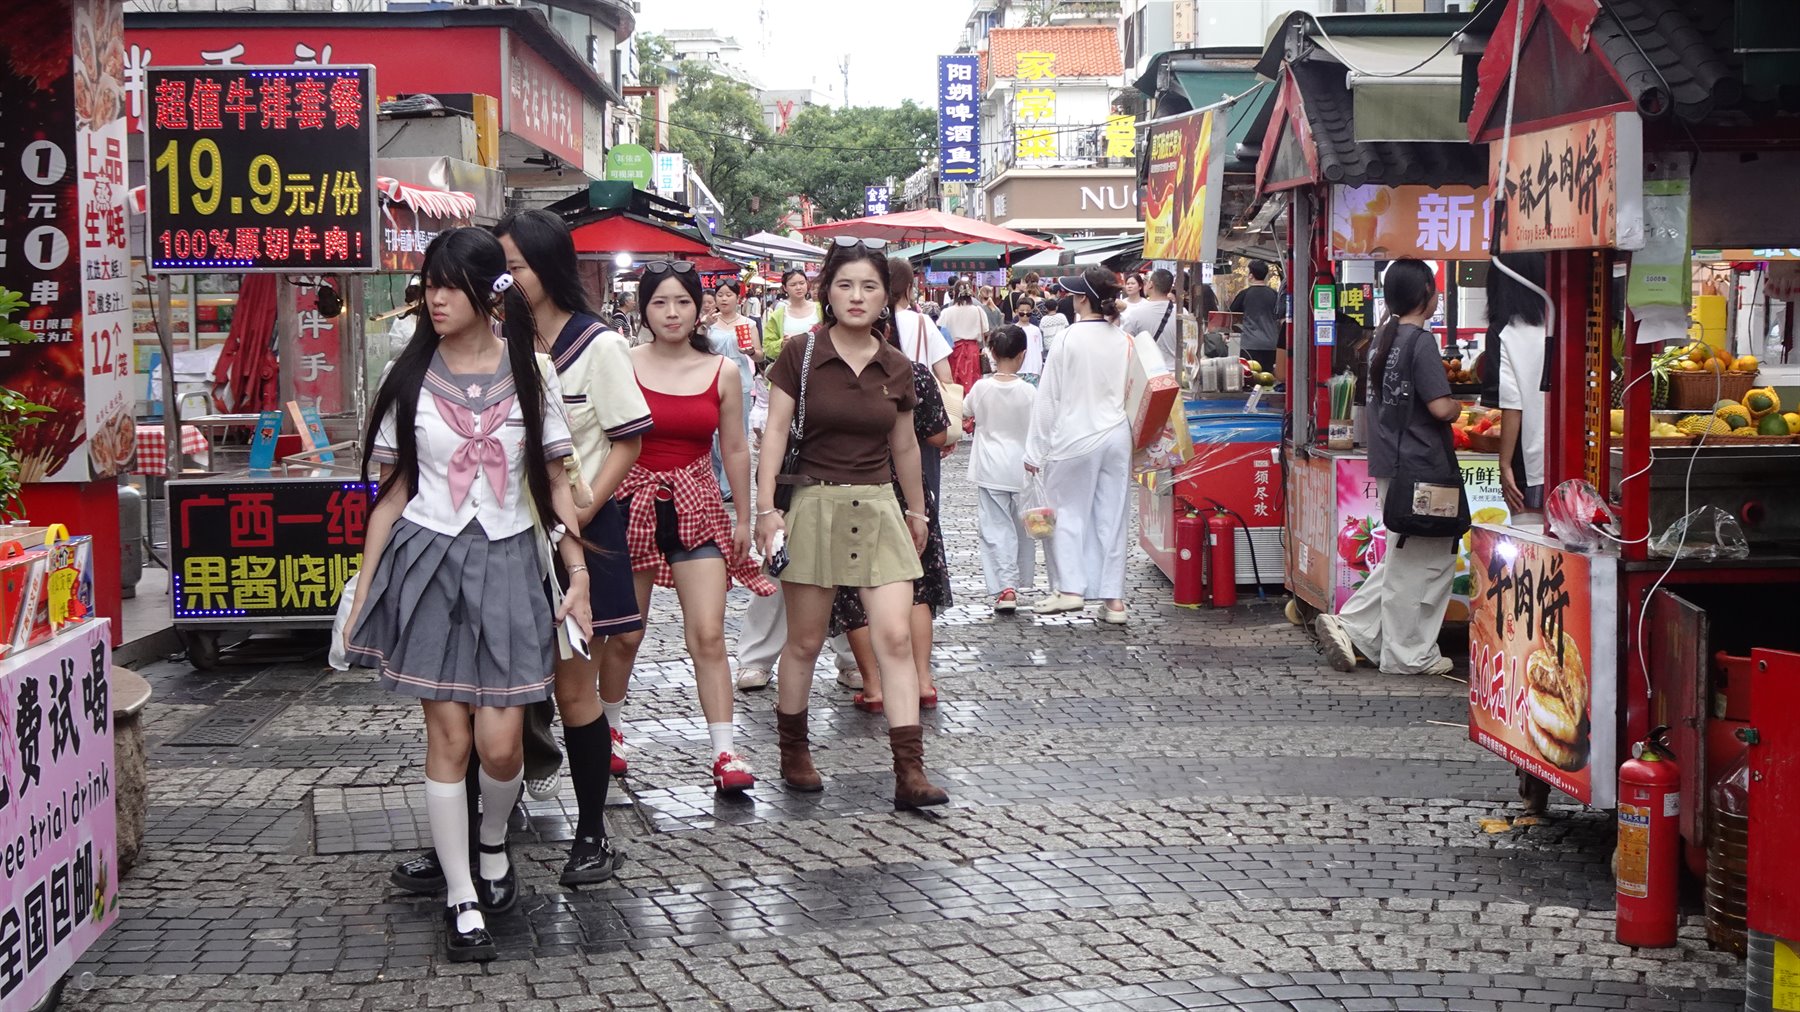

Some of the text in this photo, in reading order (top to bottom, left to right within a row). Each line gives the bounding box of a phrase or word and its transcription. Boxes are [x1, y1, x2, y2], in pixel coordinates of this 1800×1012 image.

[155, 77, 362, 130] 超值牛排套餐
[945, 63, 975, 164] 阳朔啤酒鱼
[1016, 50, 1057, 159] 家常菜
[83, 133, 123, 185] 上品
[155, 138, 362, 216] 19.9元/份
[867, 188, 888, 202] 金奖
[1080, 184, 1139, 211] NU
[1416, 193, 1490, 252] 新
[85, 200, 126, 249] 生蚝
[160, 226, 362, 260] 100%原切牛肉!
[1516, 226, 1534, 244] Crispy
[181, 491, 367, 548] 广西一绝
[1254, 470, 1269, 517] 须尽欢
[1487, 552, 1570, 667] 牛肉饼
[1470, 640, 1530, 735] 10元/个
[0, 640, 108, 812] 费试喝
[30, 790, 67, 858] trial
[72, 761, 110, 825] drink
[0, 840, 93, 1000] 全国包邮
